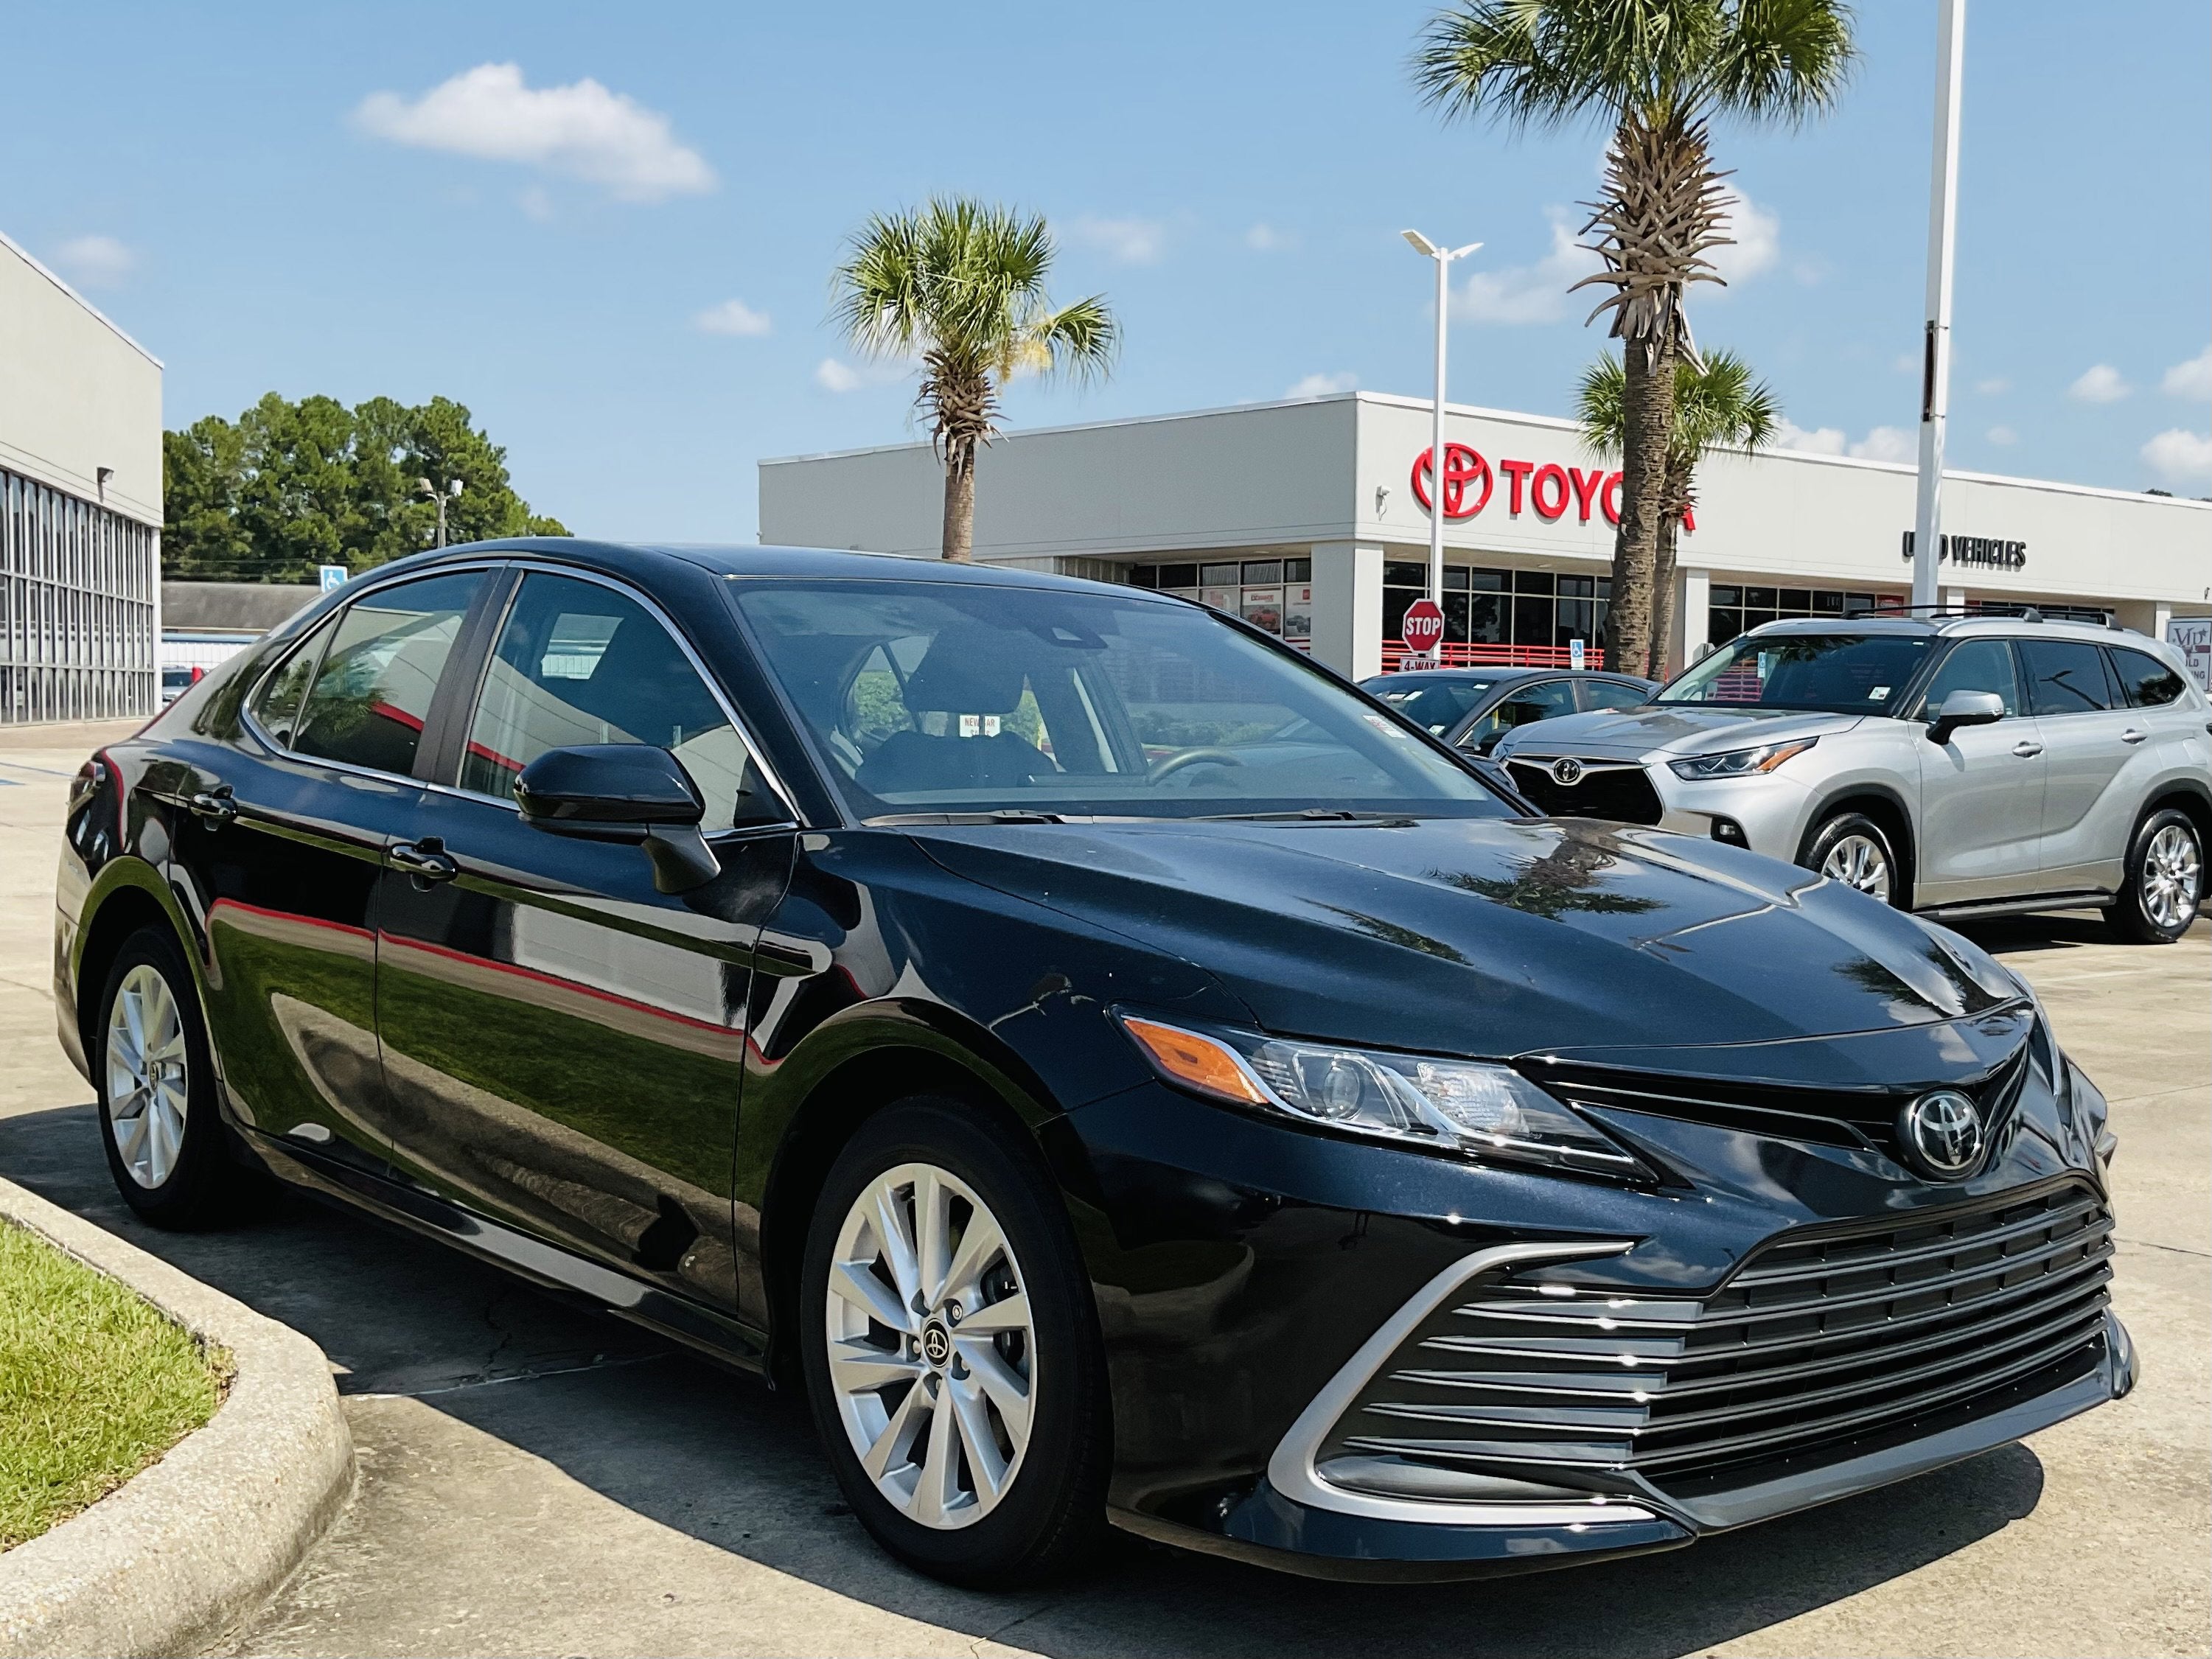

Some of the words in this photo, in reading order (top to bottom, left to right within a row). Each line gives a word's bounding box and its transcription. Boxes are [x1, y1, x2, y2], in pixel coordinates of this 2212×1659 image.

[1501, 460, 1695, 530] TOYO
[1902, 531, 1949, 560] UD
[1951, 535, 2026, 567] VEHICLES
[1406, 617, 1441, 635] STOP
[1404, 660, 1436, 671] 4-WAY
